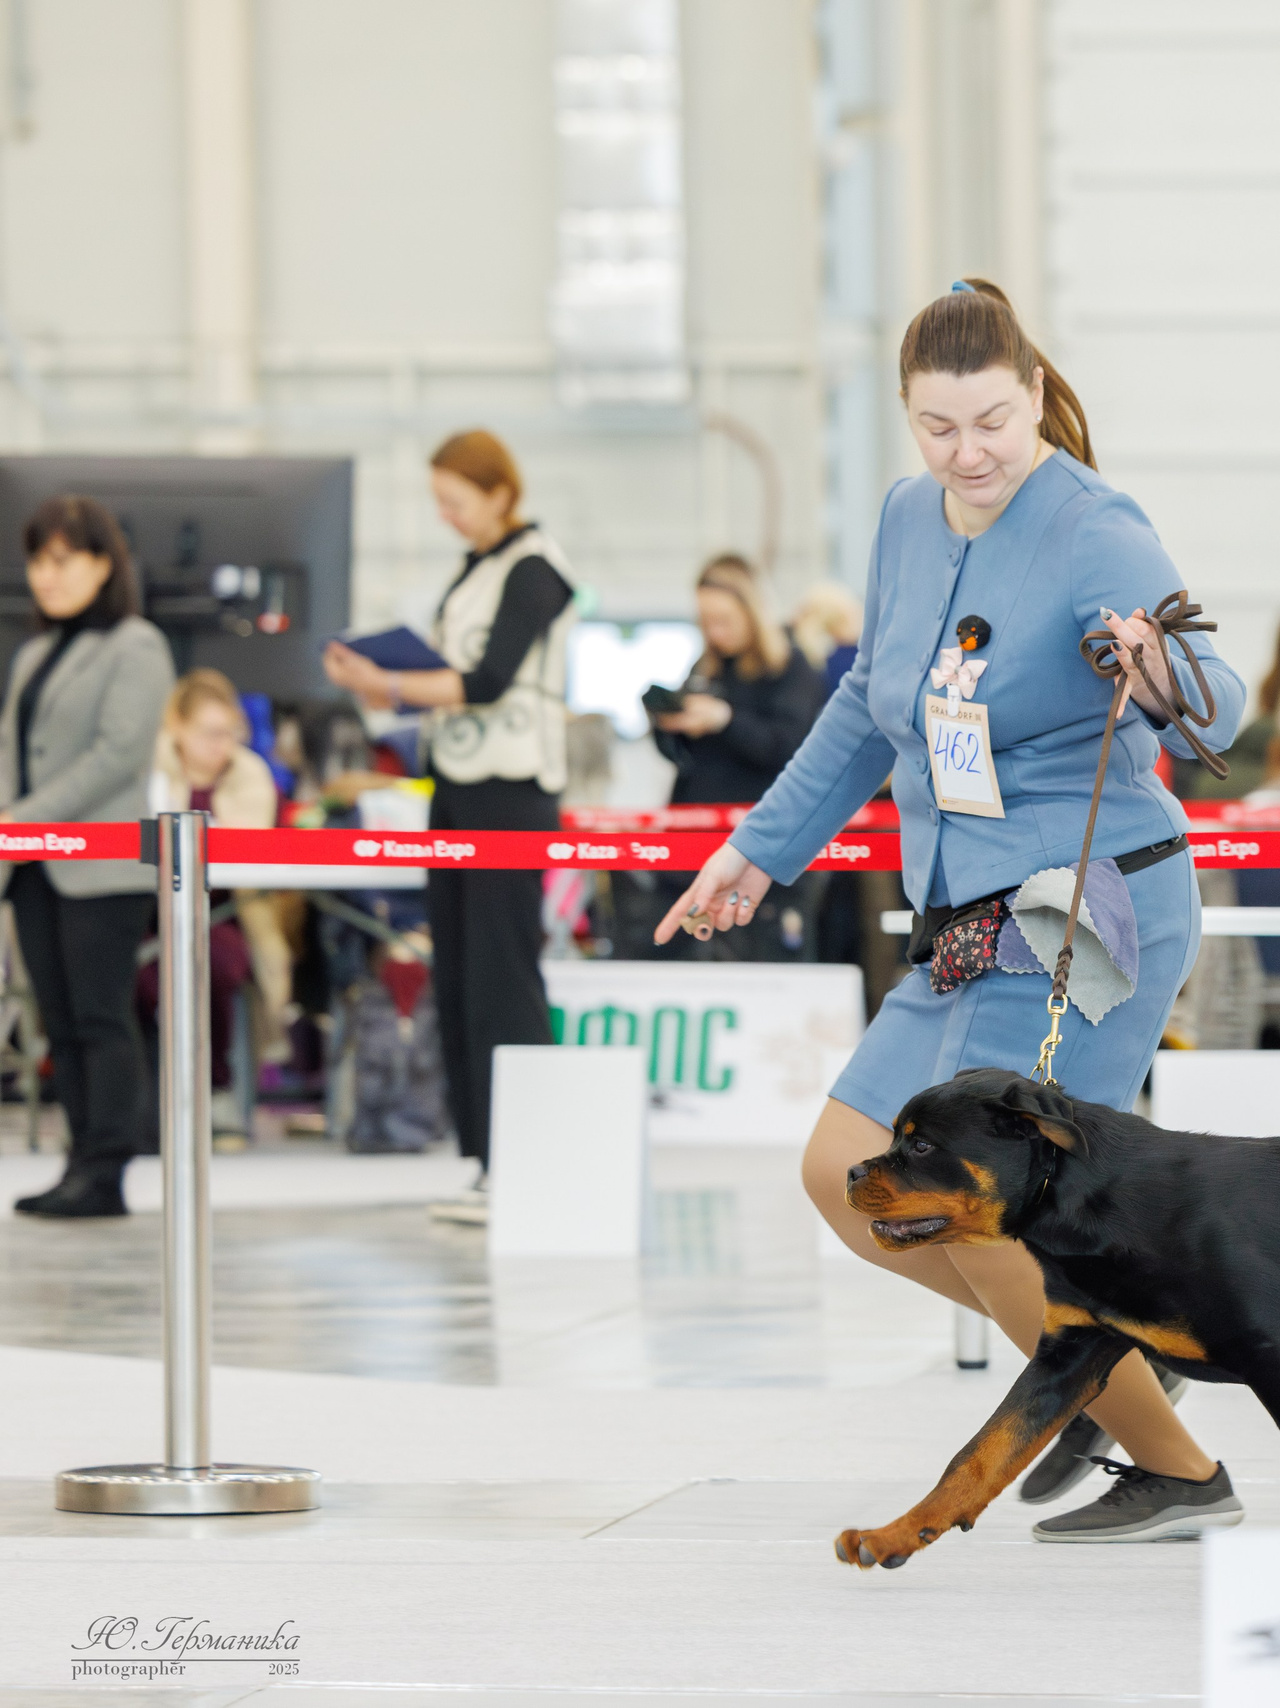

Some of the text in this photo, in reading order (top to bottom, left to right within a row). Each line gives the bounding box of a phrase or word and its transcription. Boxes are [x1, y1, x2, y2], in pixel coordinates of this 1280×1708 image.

[930, 705, 973, 721] GRAORF
[934, 723, 982, 774] 462
[44, 833, 87, 855] Expo
[433, 840, 476, 861] Expo
[829, 841, 871, 862] Expo
[1217, 839, 1260, 860] Expo
